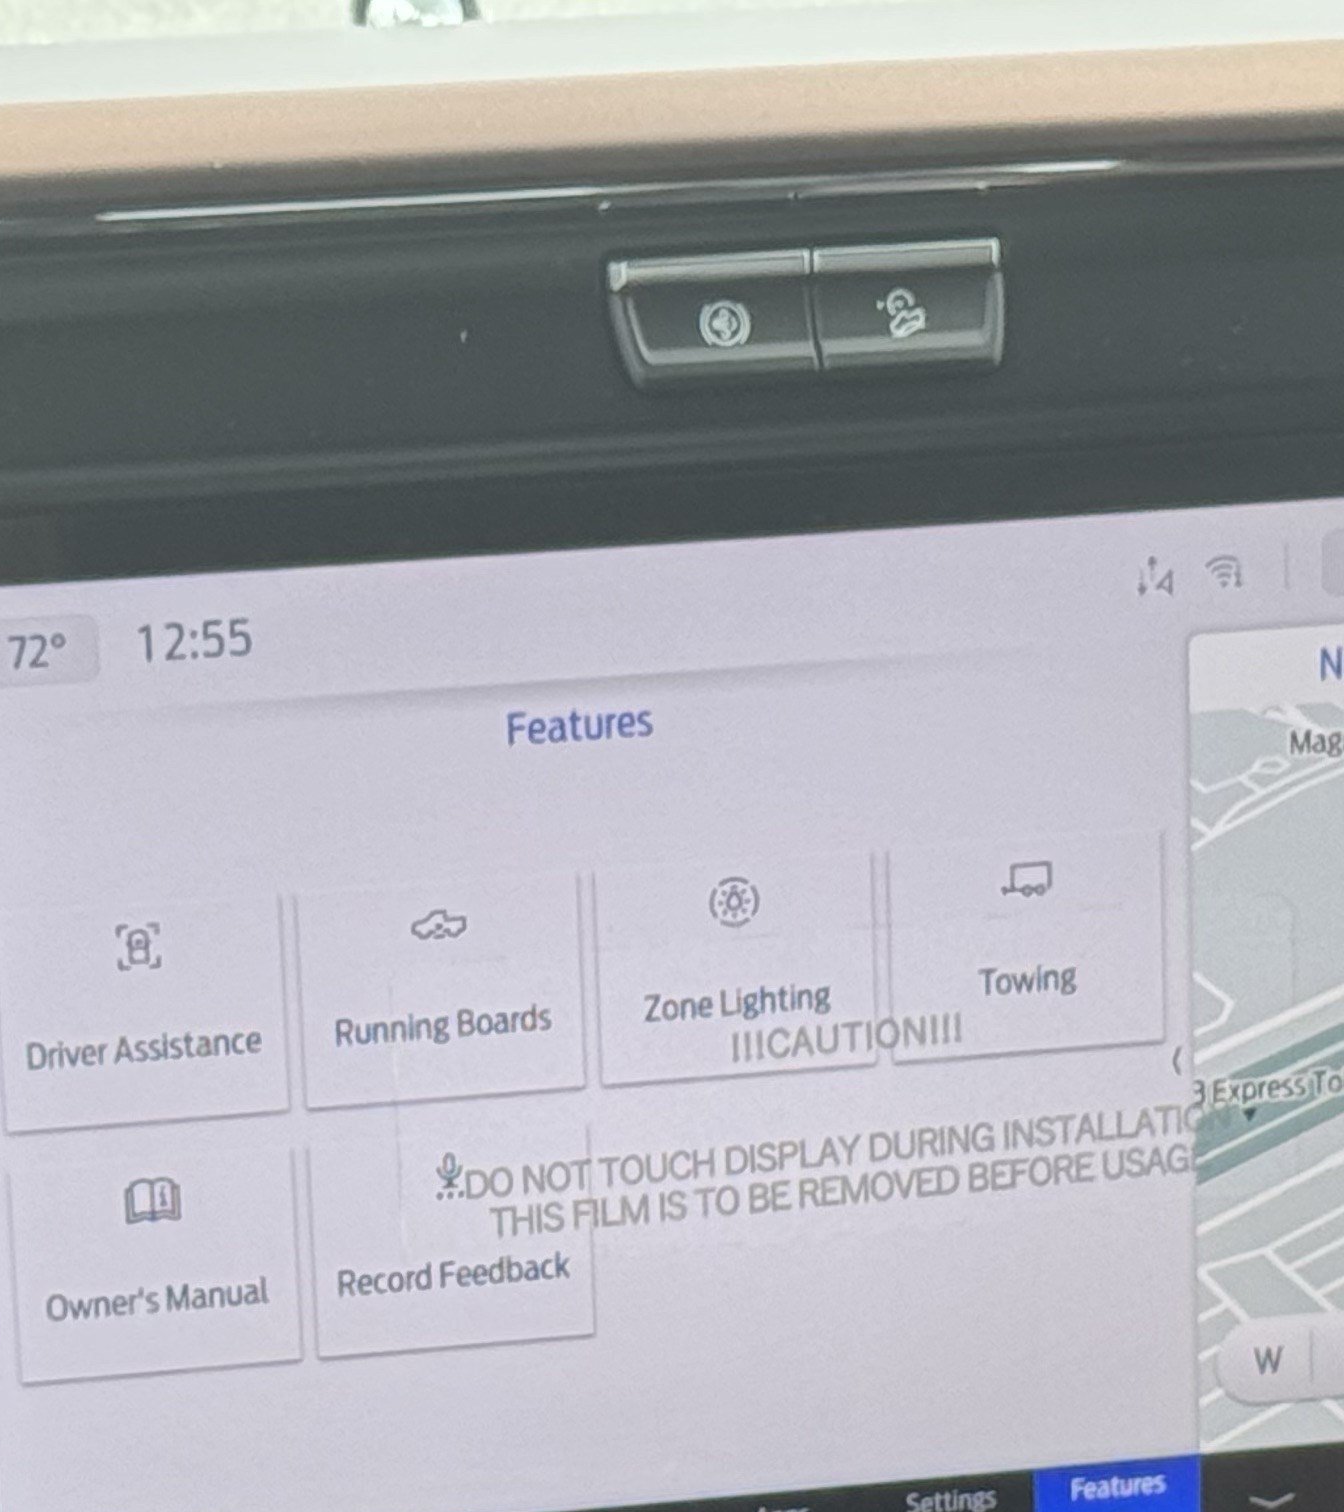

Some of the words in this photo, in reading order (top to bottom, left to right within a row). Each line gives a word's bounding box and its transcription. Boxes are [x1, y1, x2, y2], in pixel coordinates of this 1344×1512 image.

[8, 633, 67, 670] 72°
[137, 617, 253, 663] 12:55
[506, 708, 654, 747] Features
[978, 964, 1077, 998] Towing
[643, 991, 713, 1023] Zone
[720, 983, 832, 1020] Lighting
[335, 1013, 449, 1049] Running
[456, 1003, 552, 1038] Boards
[26, 1040, 106, 1072] Driver
[113, 1029, 263, 1065] Assistance
[1212, 1075, 1306, 1107] Express
[464, 1166, 514, 1200] DO
[522, 1158, 592, 1195] NOT
[598, 1147, 716, 1188] TOUCH
[724, 1133, 860, 1176] DISPLAY
[868, 1122, 995, 1163] DURING
[489, 1201, 565, 1238] THIS
[572, 1193, 651, 1230] FILM
[659, 1188, 688, 1223] IS
[691, 1184, 741, 1218] TO
[748, 1179, 793, 1215] BE
[798, 1164, 960, 1207] REMOVED
[968, 1151, 1096, 1193] BEFORE
[1102, 1141, 1197, 1182] USAG
[336, 1261, 433, 1298] Record
[439, 1249, 571, 1288] Feedback
[45, 1286, 161, 1323] Owner's
[165, 1276, 270, 1312] Manual
[1253, 1347, 1284, 1376] W
[1071, 1472, 1167, 1503] Features
